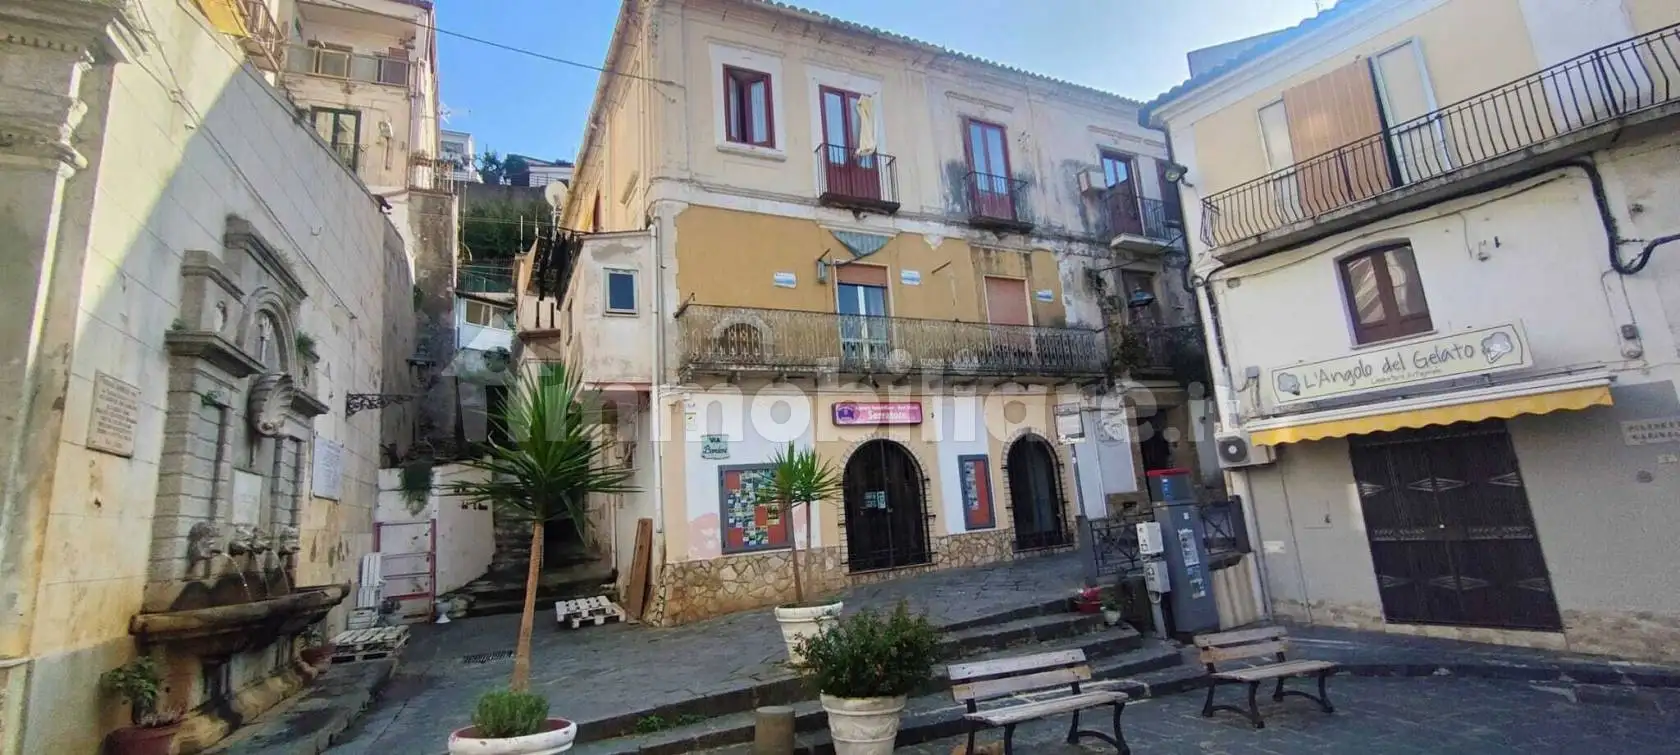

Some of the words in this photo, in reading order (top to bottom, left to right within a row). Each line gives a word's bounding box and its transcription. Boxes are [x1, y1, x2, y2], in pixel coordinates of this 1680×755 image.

[1303, 360, 1372, 389] L'Angolo
[1382, 351, 1406, 374] del
[1412, 343, 1475, 368] Gelato
